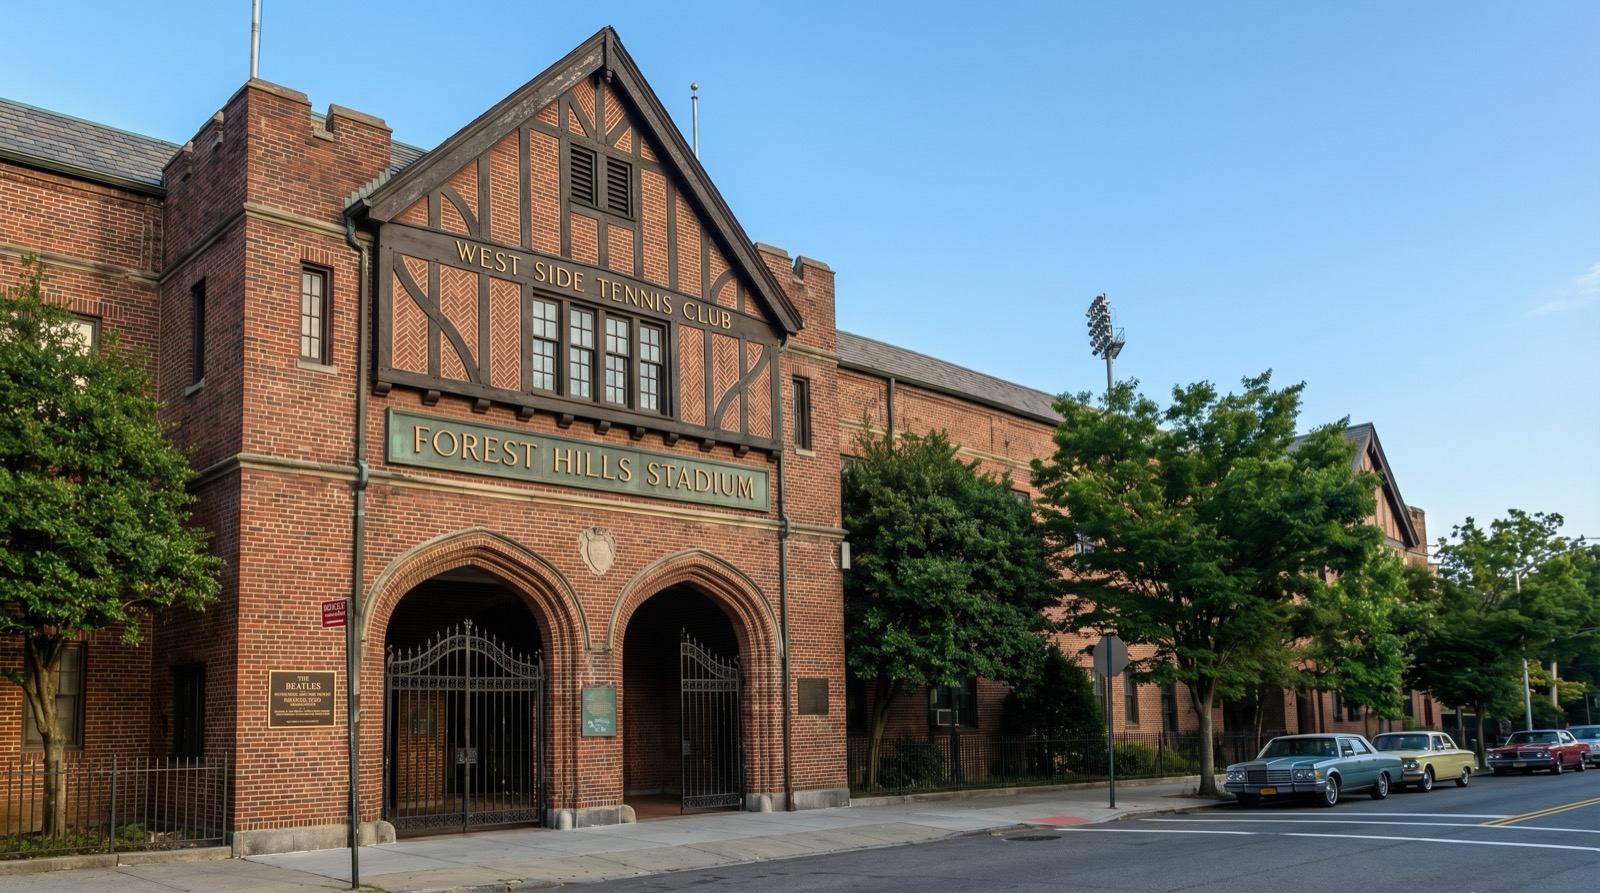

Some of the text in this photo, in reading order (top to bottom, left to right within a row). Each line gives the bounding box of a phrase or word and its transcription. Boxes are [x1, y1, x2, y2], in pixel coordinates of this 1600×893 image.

[456, 240, 732, 330] WEST SIDE TENNIS CLUB
[413, 425, 755, 500] FOREST HILLS STADIUM
[285, 682, 321, 690] BEATLES
